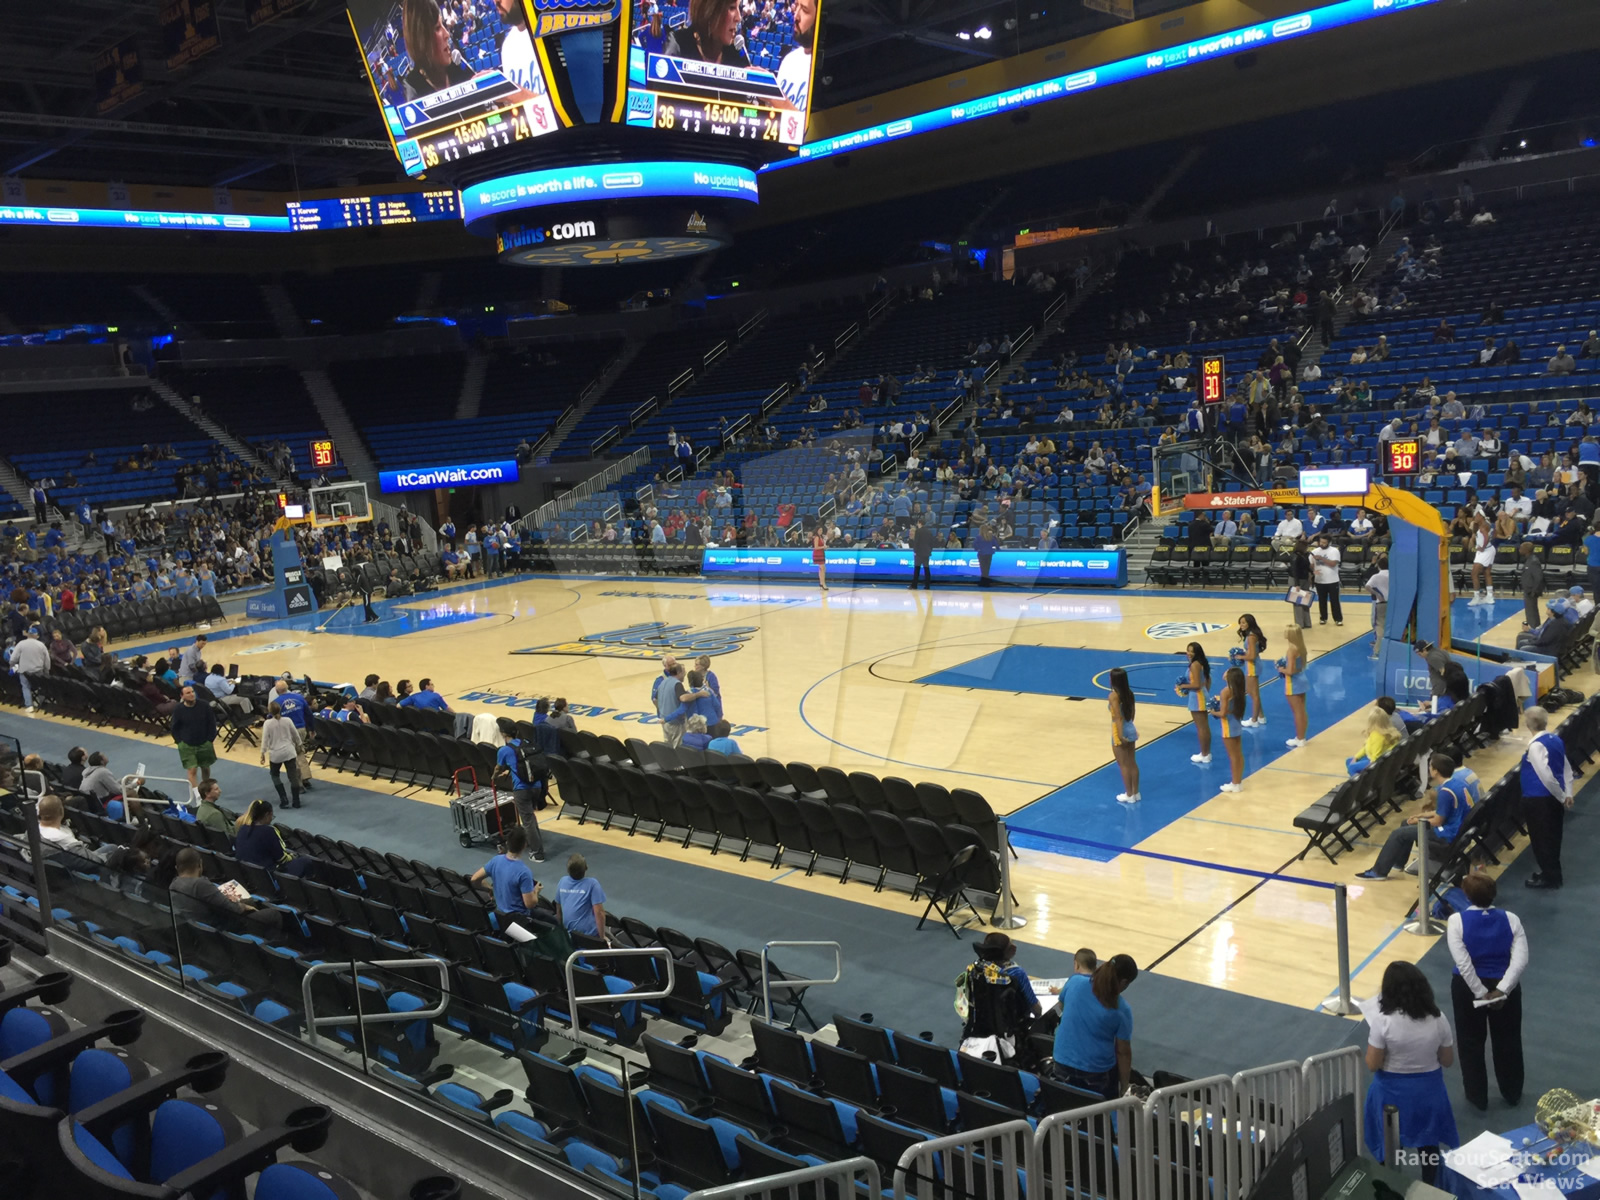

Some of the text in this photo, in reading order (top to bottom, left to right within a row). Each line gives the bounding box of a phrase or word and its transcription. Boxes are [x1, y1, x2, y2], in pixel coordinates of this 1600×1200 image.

[539, 12, 612, 35] BRUINS
[1146, 28, 1266, 68] No text is worth a life.
[951, 82, 1062, 119] No update is worth a life.
[658, 105, 675, 128] 36
[704, 104, 739, 124] 15:00
[455, 120, 487, 144] 15:00
[511, 116, 529, 141] 24
[682, 118, 700, 132] 4 3
[726, 126, 731, 135] 2
[739, 125, 757, 139] 3 3
[763, 119, 778, 141] 24
[491, 132, 509, 147] 3 3
[799, 148, 811, 158] No
[811, 143, 832, 154] score
[832, 140, 839, 149] is
[840, 134, 862, 148] worth
[423, 144, 439, 167] 36
[444, 147, 460, 161] 4 3
[694, 172, 709, 184] No
[711, 175, 738, 187] update
[480, 193, 491, 204] No
[492, 188, 516, 201] score
[517, 186, 527, 197] is
[527, 180, 562, 195] worth
[563, 180, 572, 190] a
[572, 176, 597, 189] life.
[0, 209, 15, 218] rth
[140, 215, 159, 223] text
[1206, 376, 1218, 399] 30
[314, 442, 331, 450] 15:00
[1392, 443, 1417, 454] 15:00
[316, 450, 331, 464] 30
[1394, 455, 1412, 468] 30
[397, 468, 502, 486] ItCanWait.com
[1026, 560, 1039, 568] text
[289, 600, 308, 608] adidas
[1403, 676, 1432, 690] UCL
